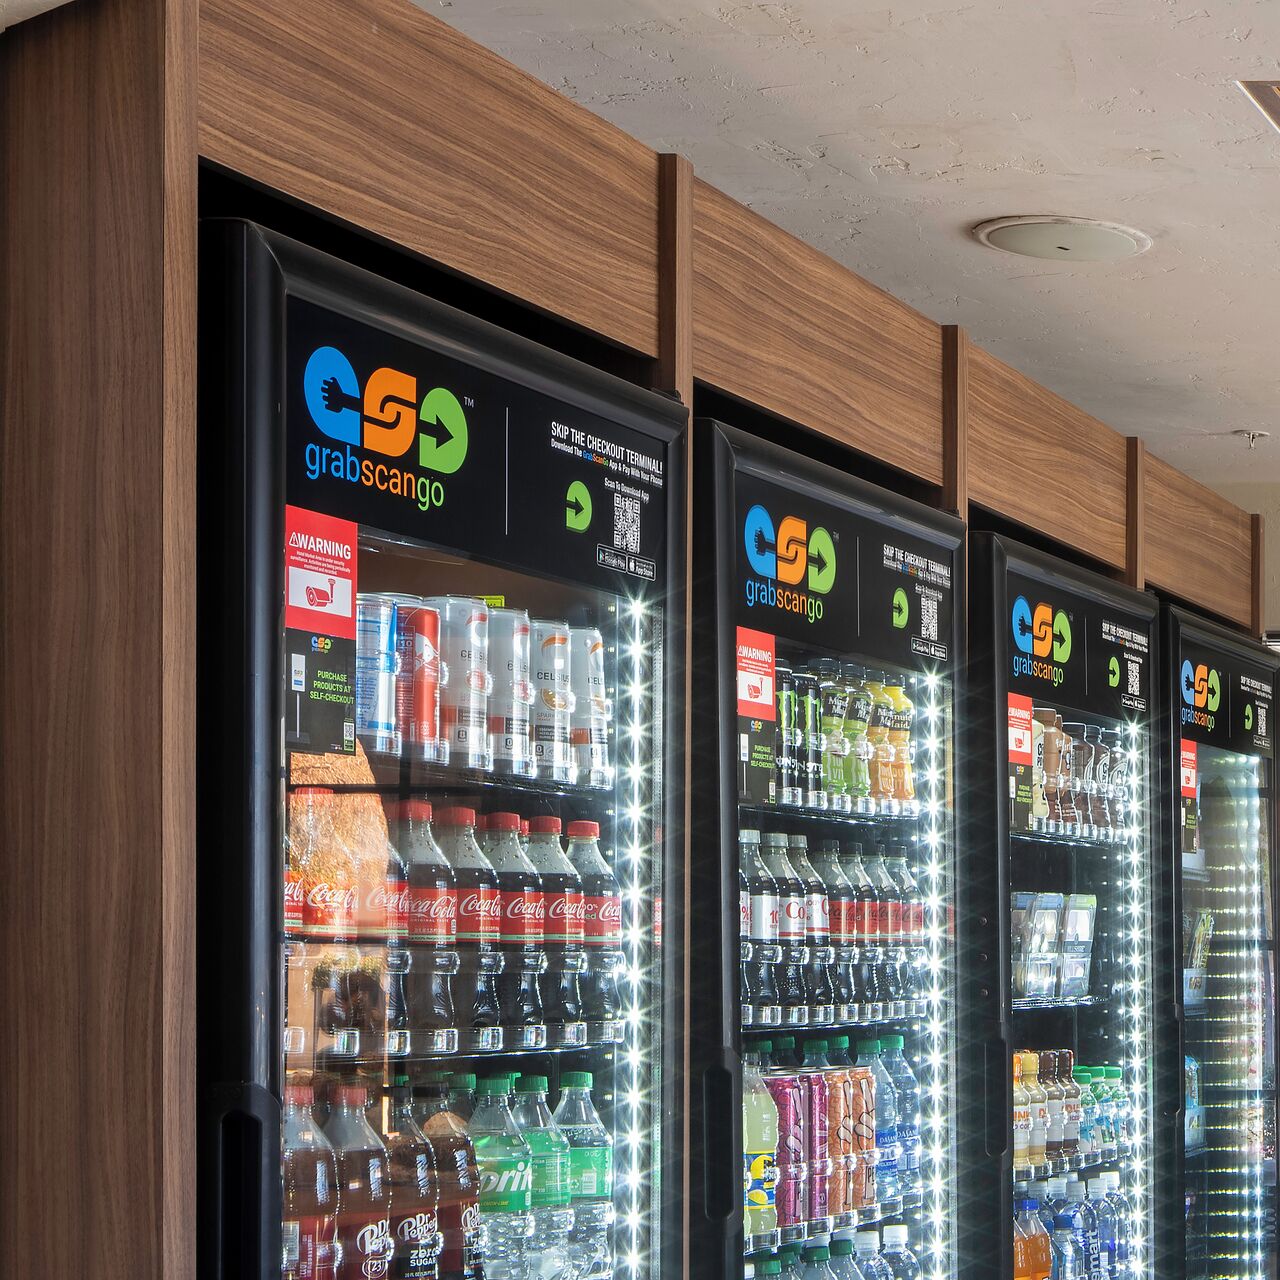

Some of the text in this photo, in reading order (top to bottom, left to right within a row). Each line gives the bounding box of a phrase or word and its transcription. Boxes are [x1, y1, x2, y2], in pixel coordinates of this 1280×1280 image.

[551, 422, 663, 474] SKIP THE CHECKOUT TERMINAL!
[551, 438, 573, 454] Download
[574, 446, 582, 457] The
[609, 460, 617, 472] App
[305, 442, 444, 511] grabscango
[604, 477, 649, 504] Scan To Download App
[298, 533, 351, 560] WARNING
[883, 544, 893, 555] SKIP
[895, 546, 903, 558] THE
[904, 548, 927, 568] CHECKOUT
[746, 577, 823, 623] grabscango
[743, 645, 771, 663] WARNING
[318, 670, 347, 682] PURCHASE
[1013, 654, 1063, 688] grabscango
[310, 691, 354, 704] SELF-CHECKOUT
[313, 681, 351, 693] PRODUCTS AT
[1181, 706, 1215, 732] grabscango
[415, 1213, 431, 1224] Dr
[371, 1261, 382, 1272] 23
